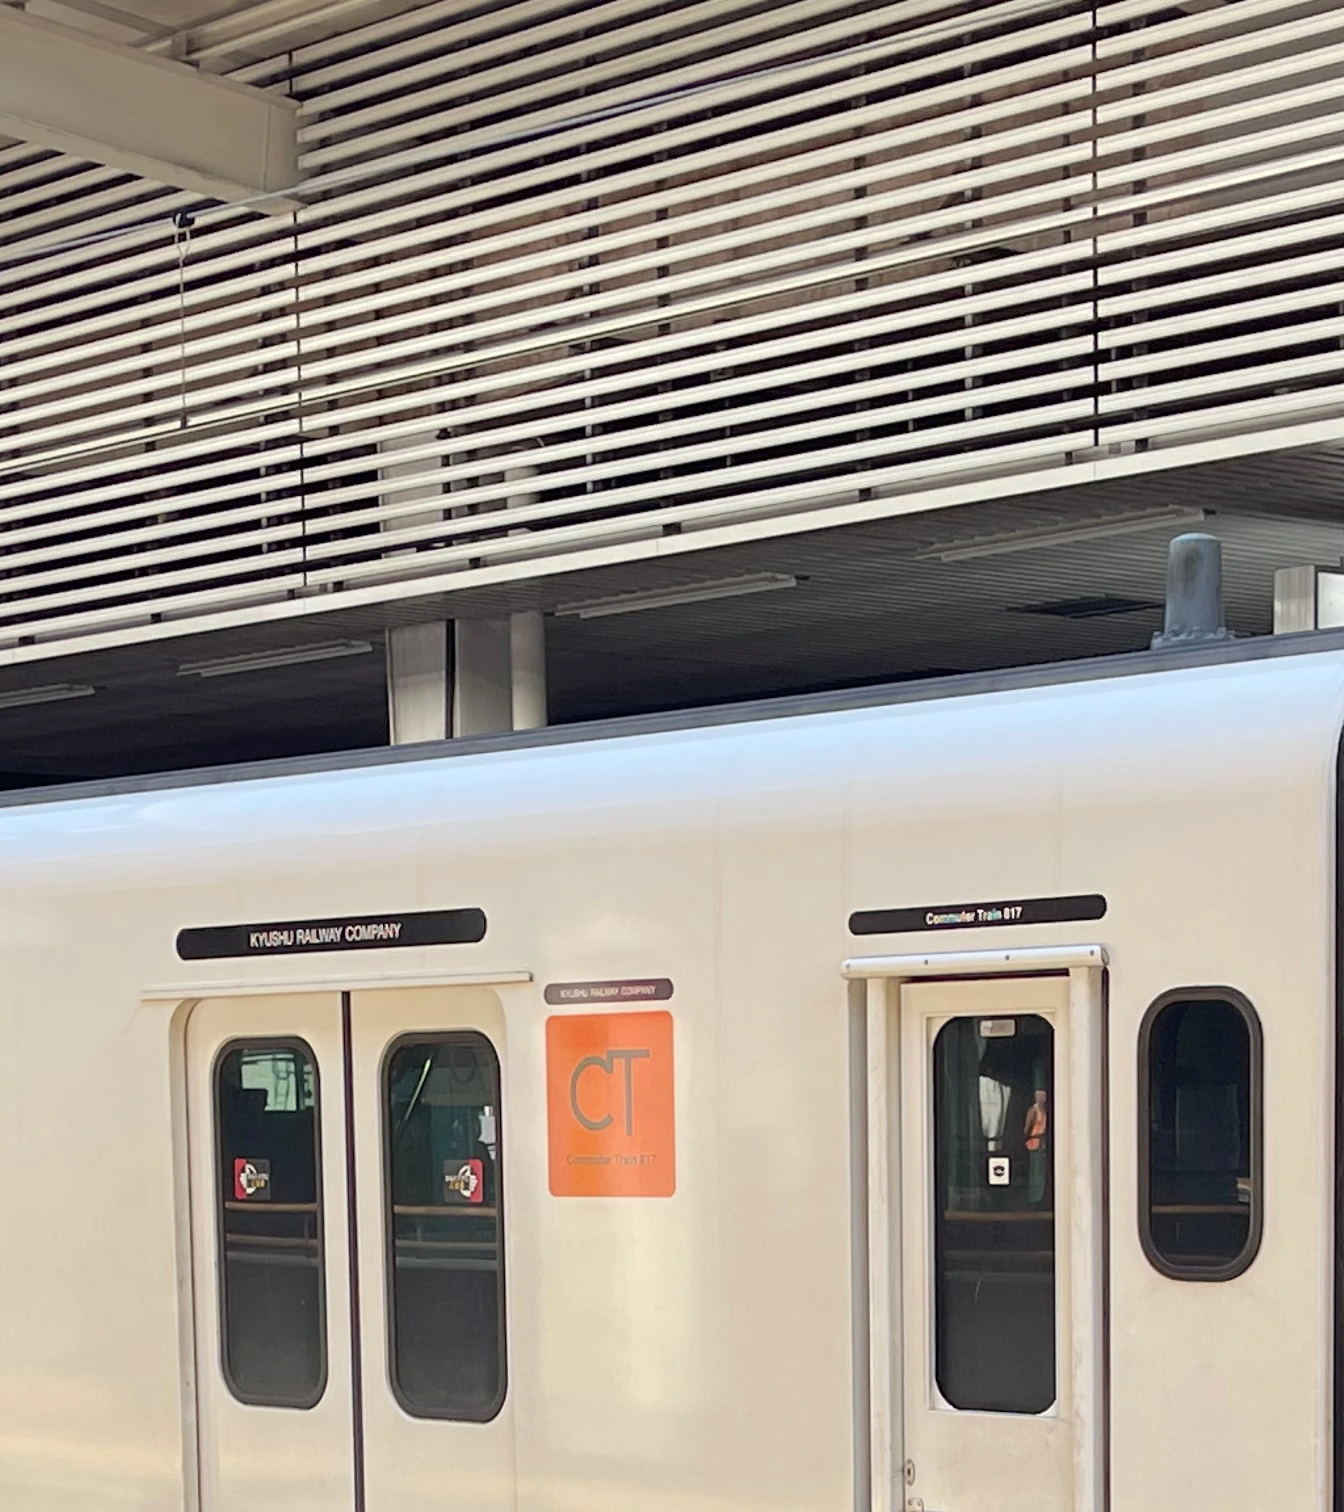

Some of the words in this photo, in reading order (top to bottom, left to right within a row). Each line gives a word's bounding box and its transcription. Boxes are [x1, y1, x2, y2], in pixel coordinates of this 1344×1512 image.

[249, 929, 294, 948] KYUSHU
[295, 926, 343, 945] RAILWAY
[344, 922, 403, 942] COMPANY
[569, 1048, 650, 1137] CT
